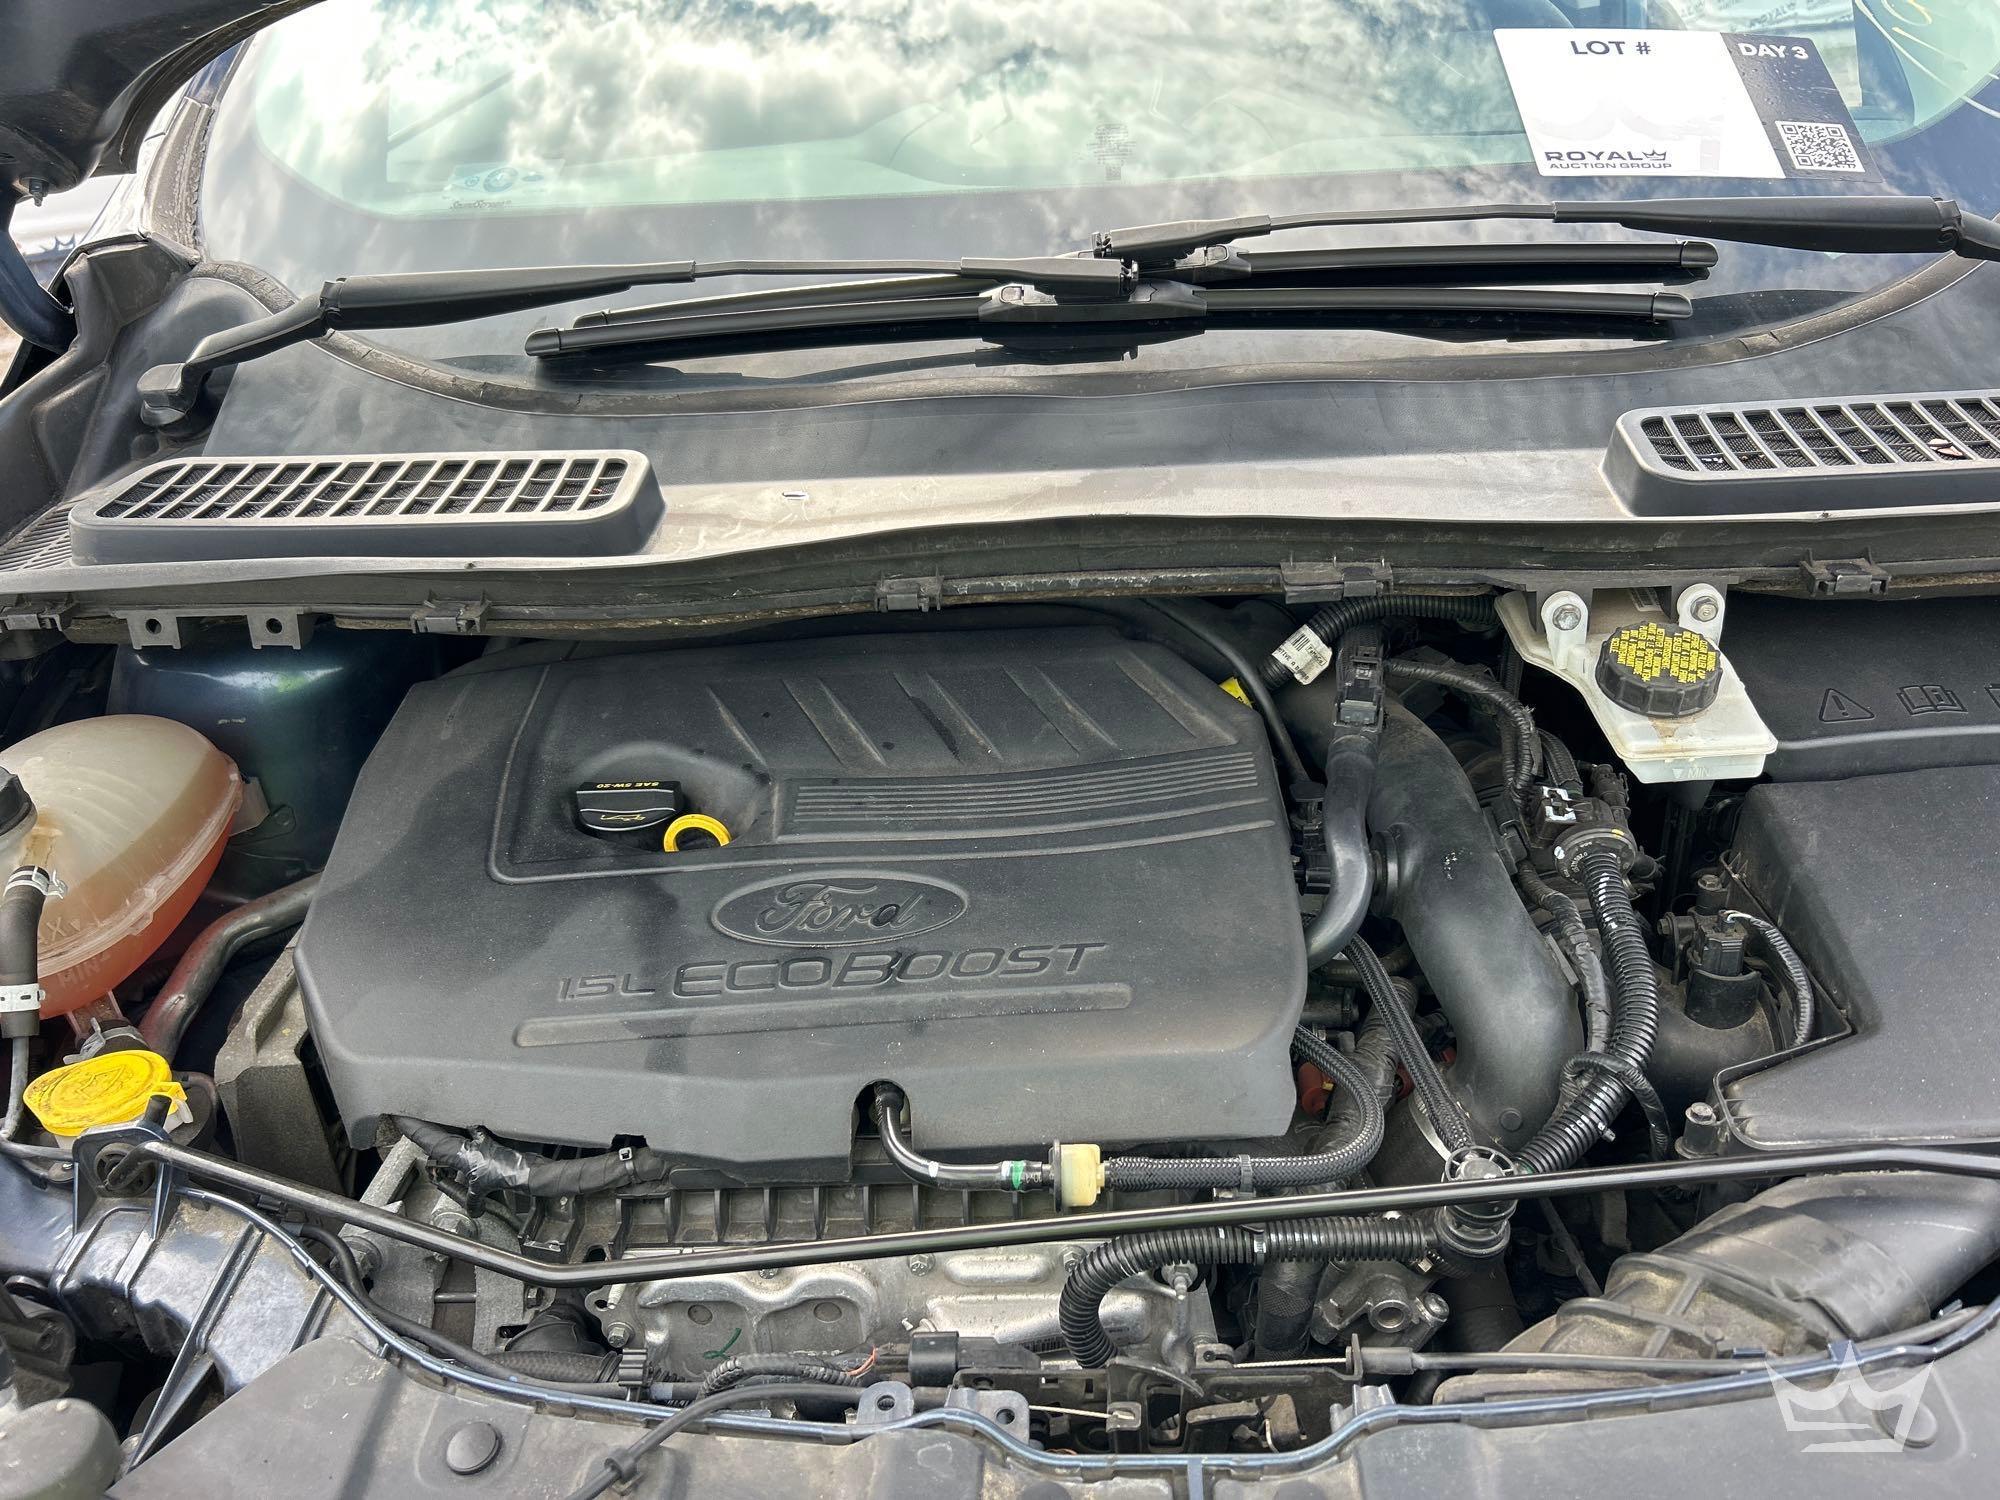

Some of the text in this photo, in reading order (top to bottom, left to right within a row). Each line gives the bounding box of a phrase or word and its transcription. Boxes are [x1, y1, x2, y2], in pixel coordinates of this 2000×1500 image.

[1570, 40, 1653, 56] LOT #
[1738, 42, 1809, 61] DAY 3
[1545, 150, 1643, 162] ROYAL
[1550, 161, 1672, 170] AUCTION GROUP
[754, 881, 923, 934] Ford
[559, 943, 1106, 1001] 1.5L ECOBOOST
